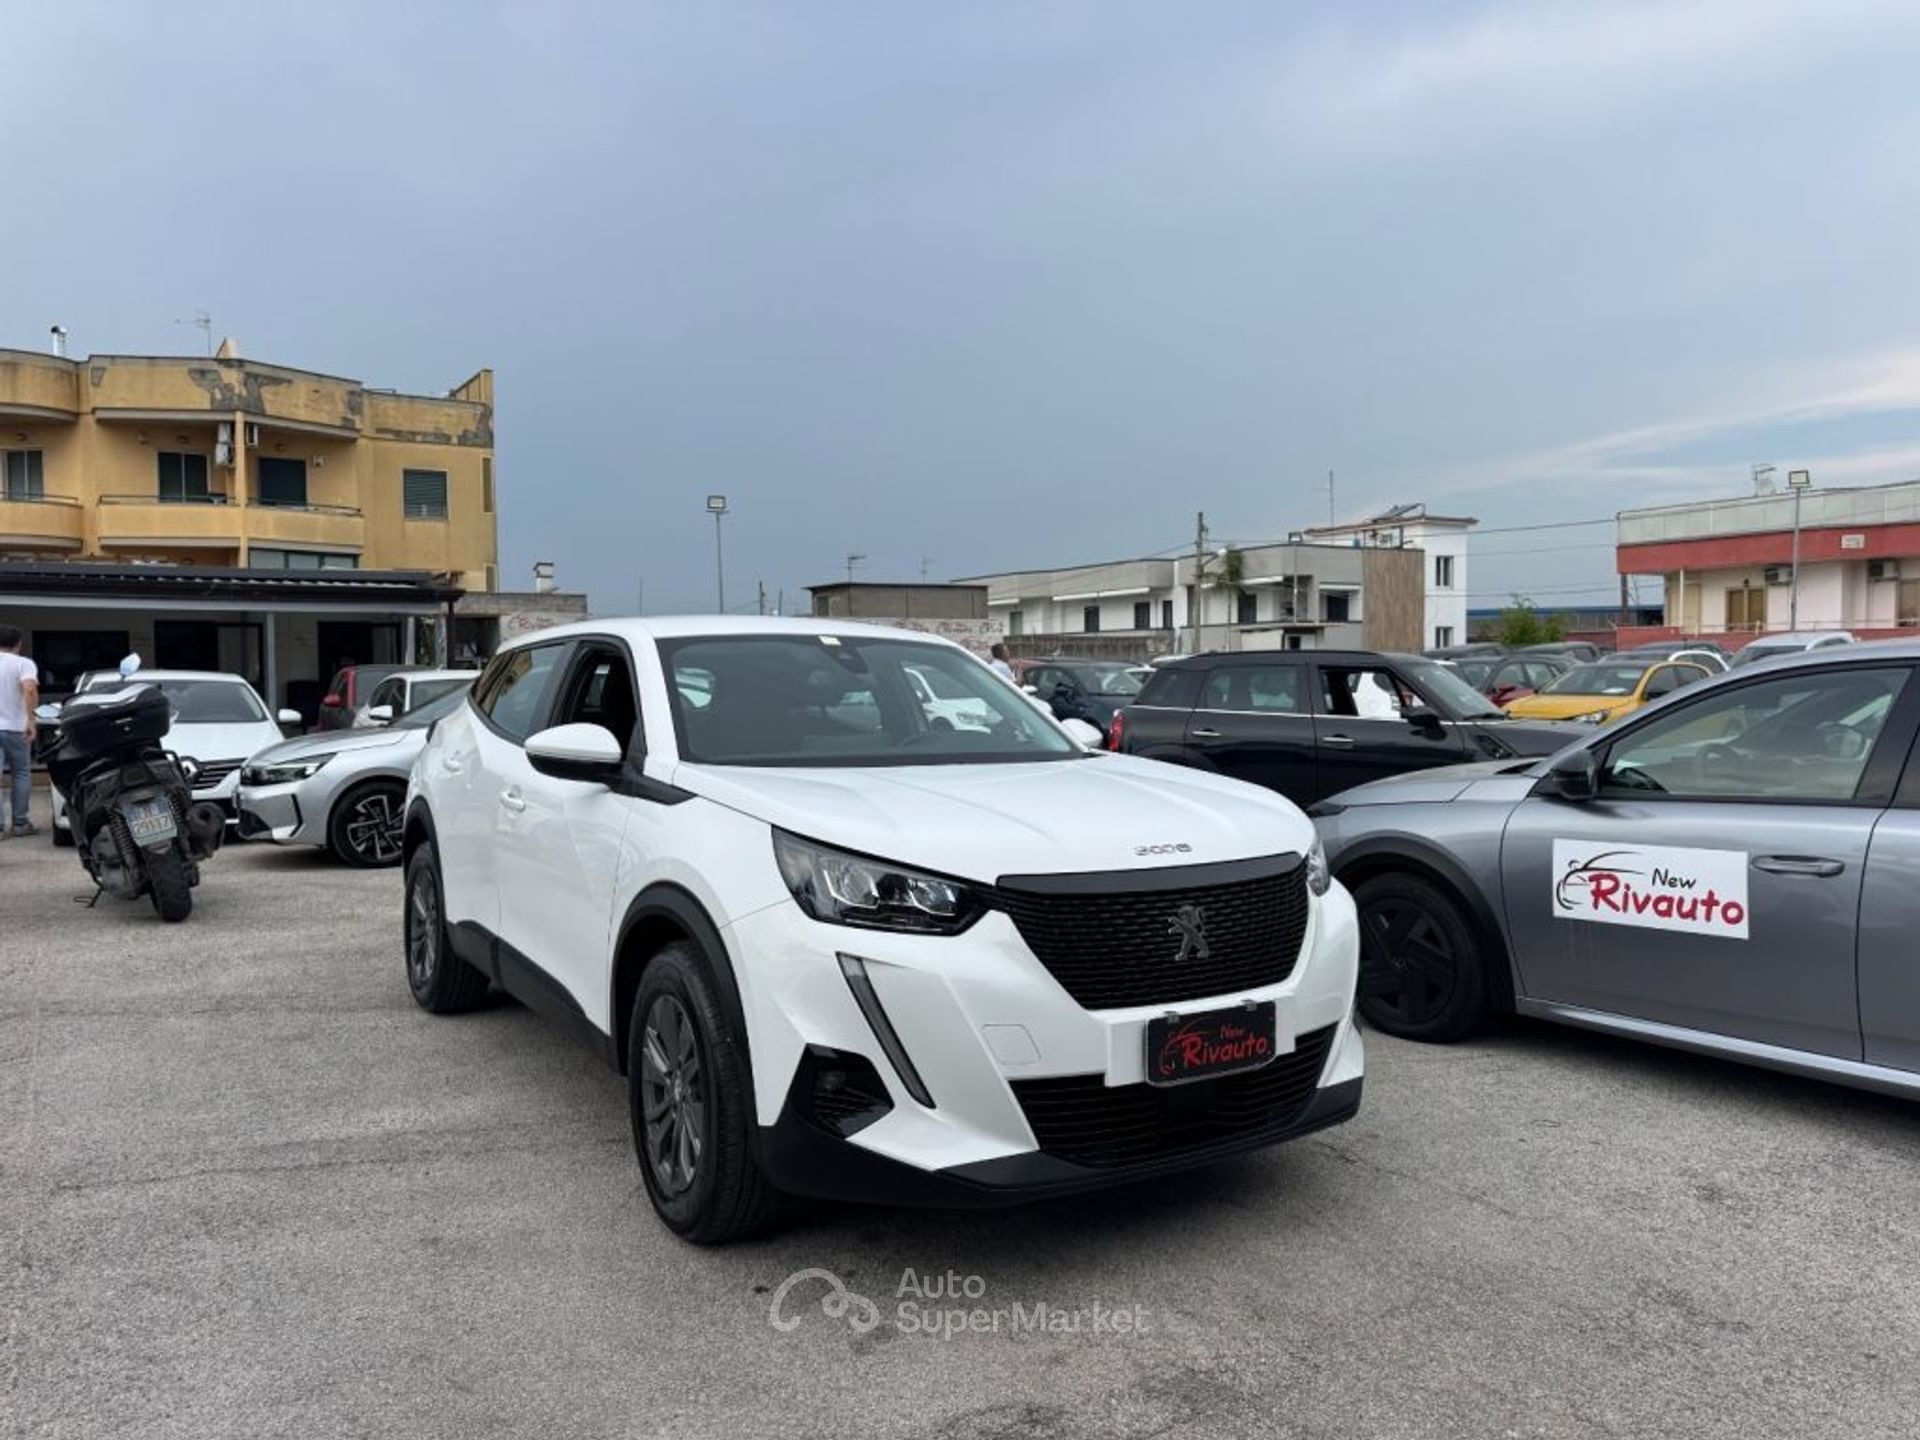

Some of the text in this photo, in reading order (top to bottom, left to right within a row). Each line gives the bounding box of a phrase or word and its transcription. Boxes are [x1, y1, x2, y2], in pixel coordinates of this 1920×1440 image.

[1134, 843, 1193, 856] 2008
[1652, 868, 1697, 889] New
[1588, 873, 1745, 925] Rivauto
[1181, 1033, 1269, 1069] Rivauto
